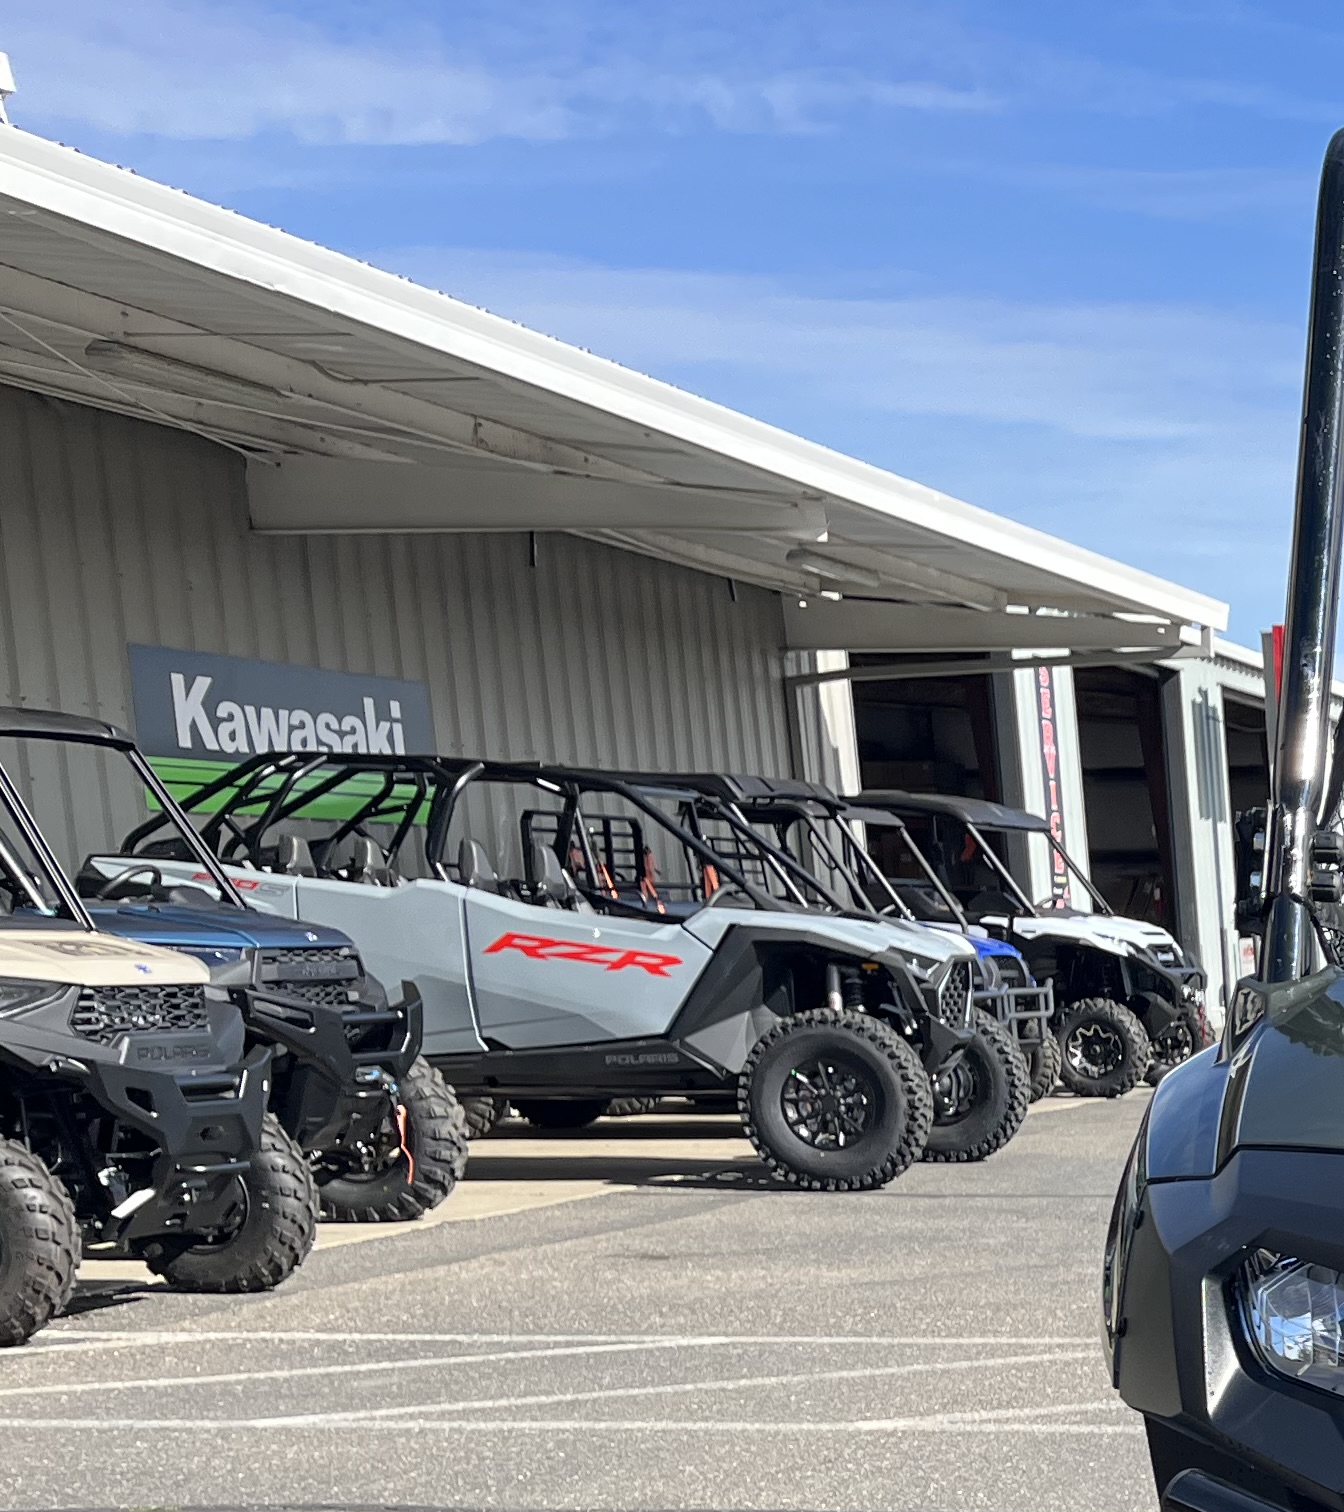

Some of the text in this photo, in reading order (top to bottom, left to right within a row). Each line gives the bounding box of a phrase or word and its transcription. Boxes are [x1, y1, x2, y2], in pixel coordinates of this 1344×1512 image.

[170, 672, 405, 755] Kawasaki
[1038, 666, 1065, 874] SERVICE
[483, 931, 683, 977] RZR
[604, 1053, 680, 1066] POLARIS
